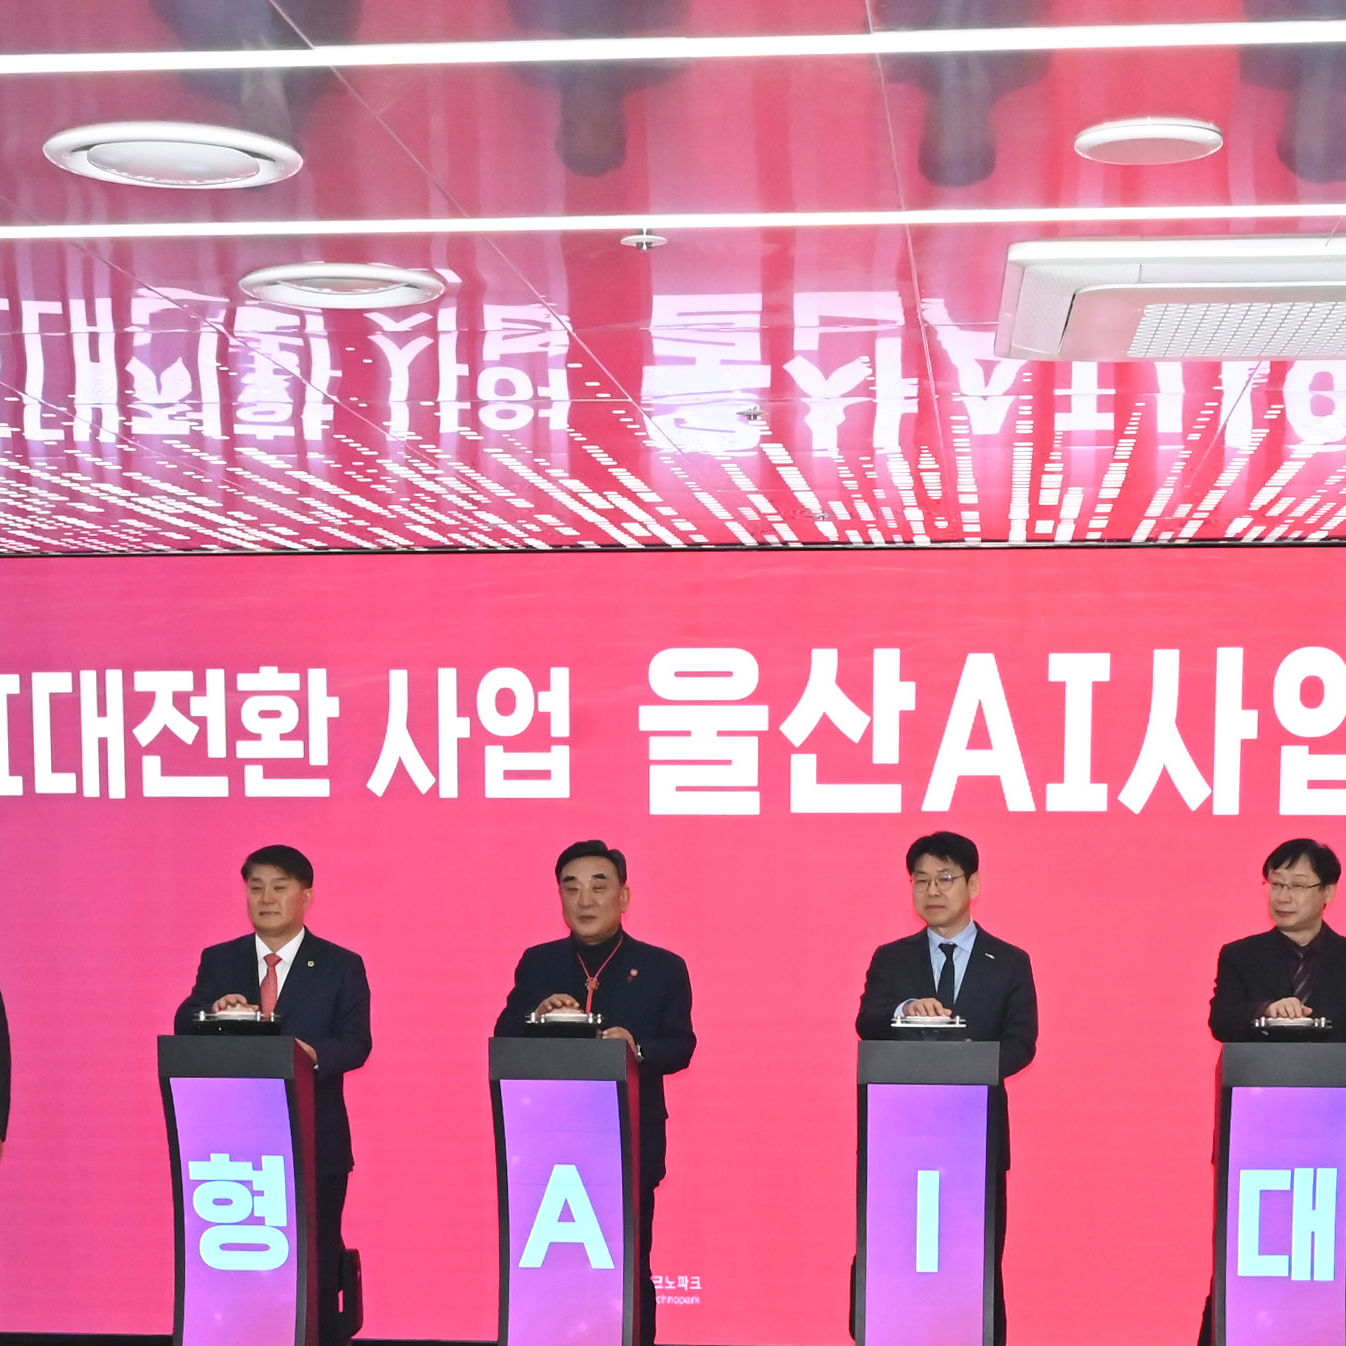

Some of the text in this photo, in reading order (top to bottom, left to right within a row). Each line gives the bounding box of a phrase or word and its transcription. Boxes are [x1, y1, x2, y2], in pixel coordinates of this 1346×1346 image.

[366, 667, 570, 799] 사업
[188, 1153, 290, 1271] 형
[518, 1164, 615, 1270] A
[1237, 1167, 1338, 1282] 대
